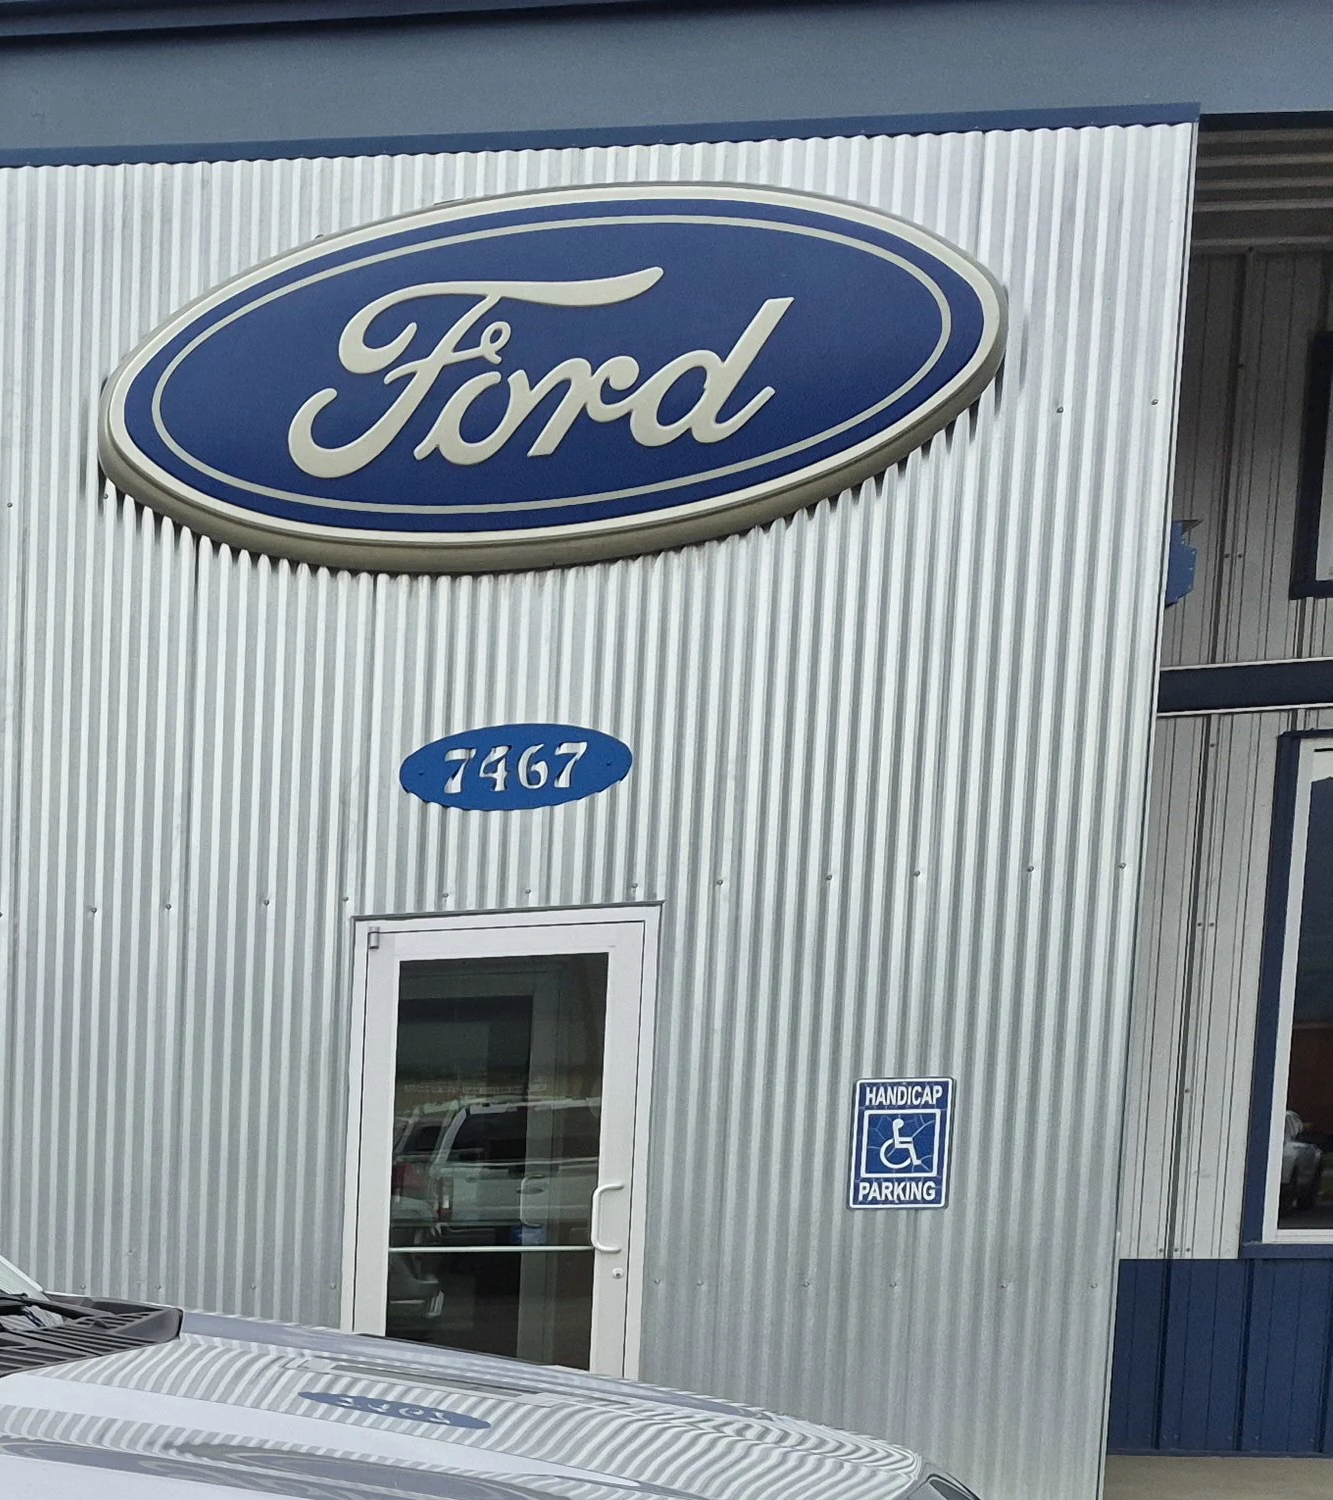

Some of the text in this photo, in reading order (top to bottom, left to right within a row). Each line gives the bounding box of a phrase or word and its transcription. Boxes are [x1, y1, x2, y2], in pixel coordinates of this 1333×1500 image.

[288, 266, 794, 478] Ford
[444, 741, 588, 794] 7467
[865, 1085, 943, 1106] HANDICAP
[858, 1181, 936, 1202] PARKING
